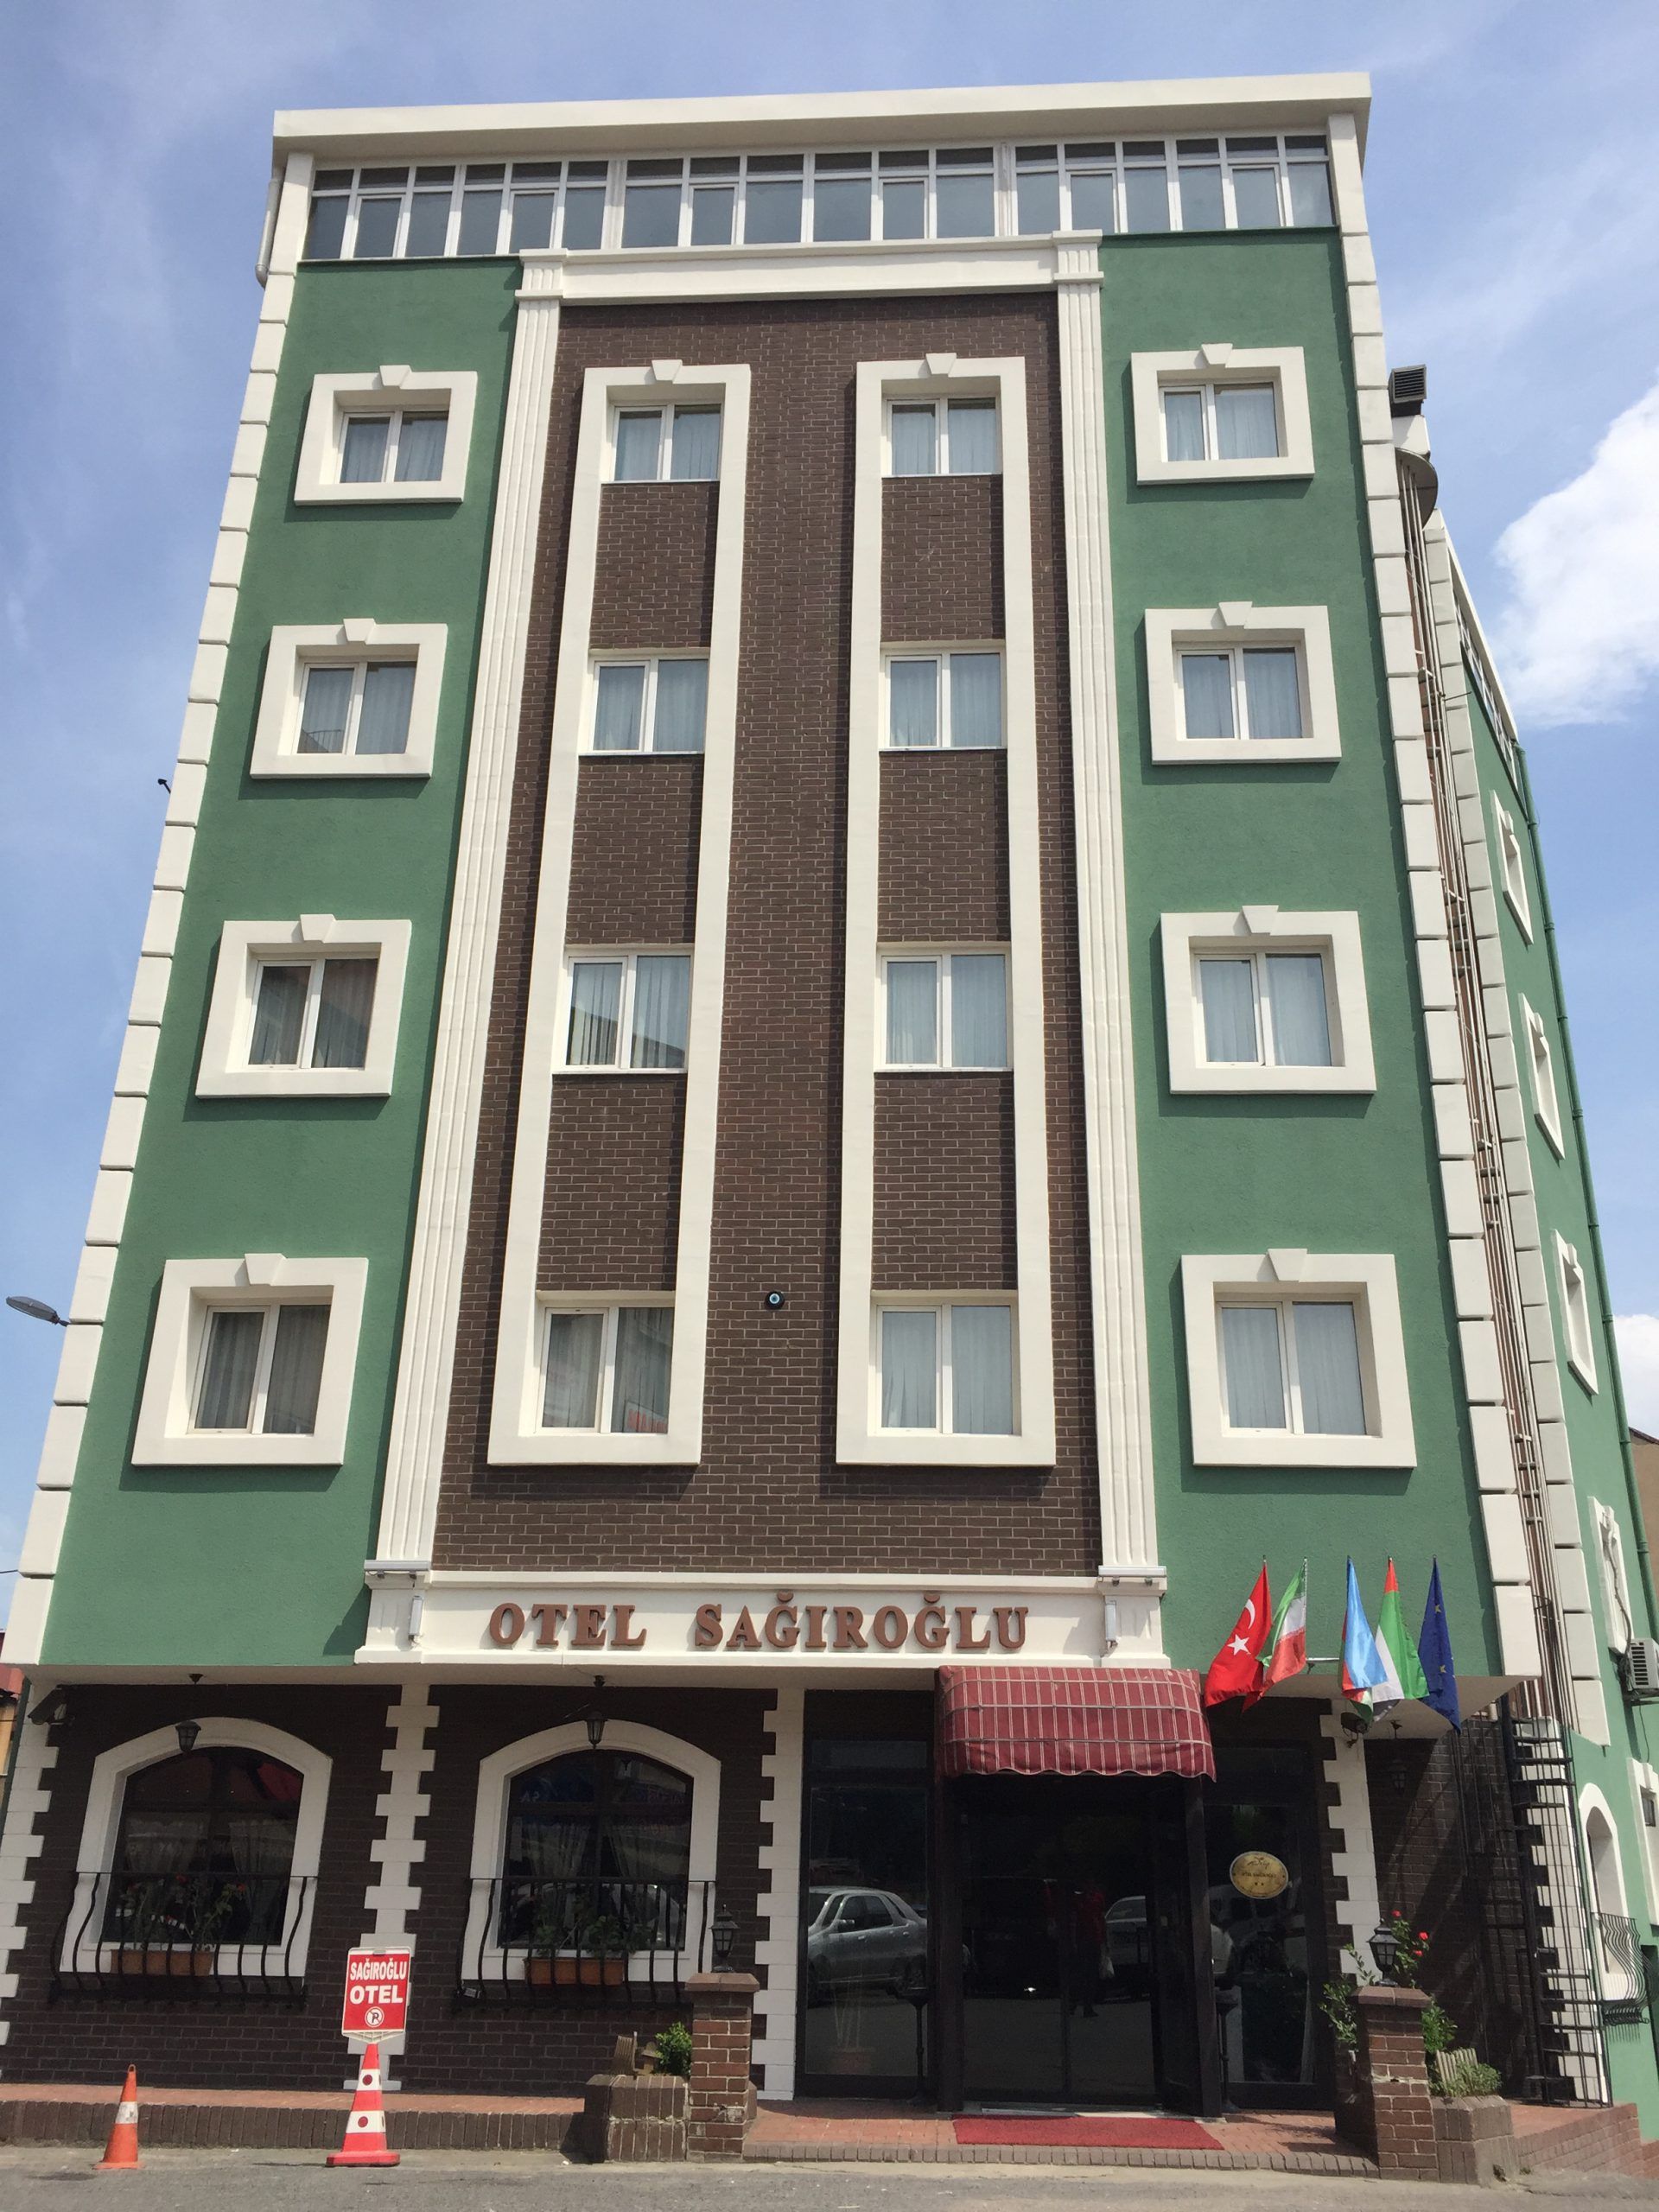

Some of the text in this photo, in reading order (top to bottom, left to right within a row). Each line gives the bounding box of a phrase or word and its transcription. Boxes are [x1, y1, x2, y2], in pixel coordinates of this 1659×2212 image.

[488, 1591, 1030, 1649] OTEL SAĞIROĞLU
[349, 1957, 408, 1981] SAĞIROĞLU
[349, 1984, 404, 2005] OTEL
